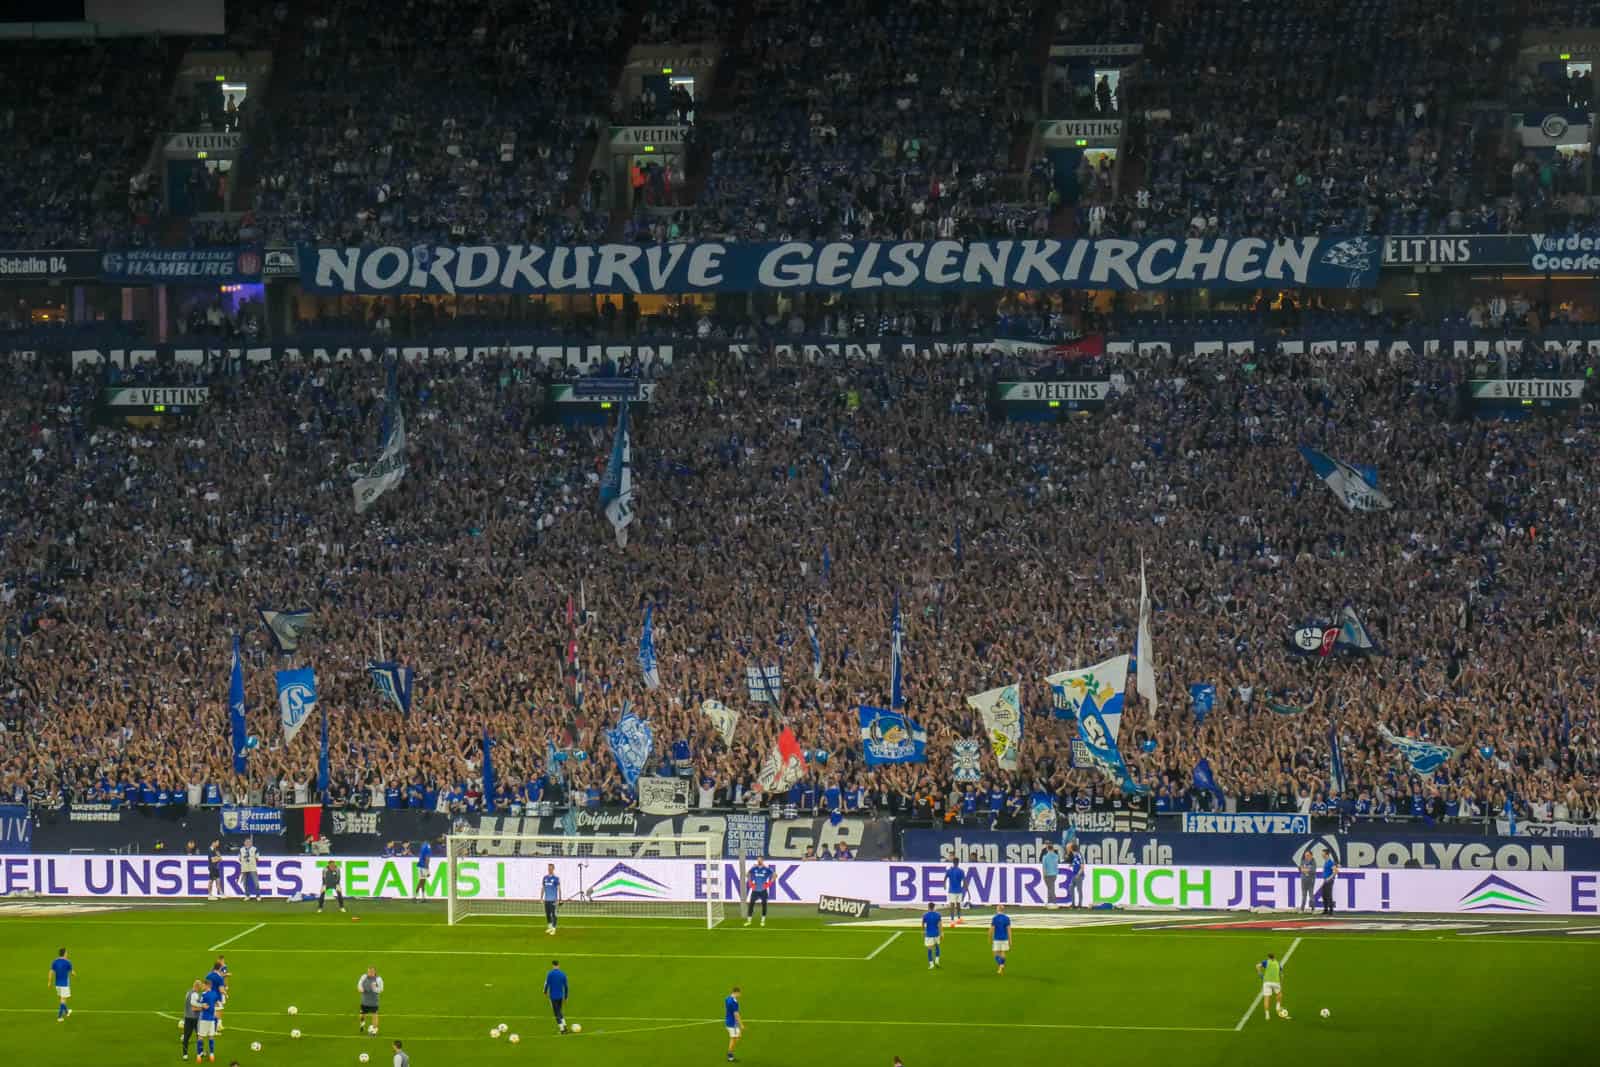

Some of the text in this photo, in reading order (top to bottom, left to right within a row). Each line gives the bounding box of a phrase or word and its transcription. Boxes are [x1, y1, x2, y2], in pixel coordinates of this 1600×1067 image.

[633, 129, 688, 143] VELTINS
[1065, 123, 1120, 136] VELTINS
[186, 135, 241, 149] VELTINS
[1384, 239, 1471, 263] ELTINS
[0, 256, 67, 275] Schalke 04
[126, 260, 233, 276] HAMBURG
[315, 236, 1319, 295] NORDKURVE GELSENKIRCHEN
[142, 389, 206, 404] VELTINS
[1034, 384, 1098, 399] VELTINS
[1506, 382, 1573, 397] VELTINS
[578, 810, 624, 831] Original
[1196, 815, 1291, 833] KURVE
[1346, 842, 1565, 870] POLYGON
[0, 858, 69, 896] EIL
[84, 859, 304, 897] UNSERES
[1092, 868, 1212, 907] DICH
[819, 896, 866, 918] betway
